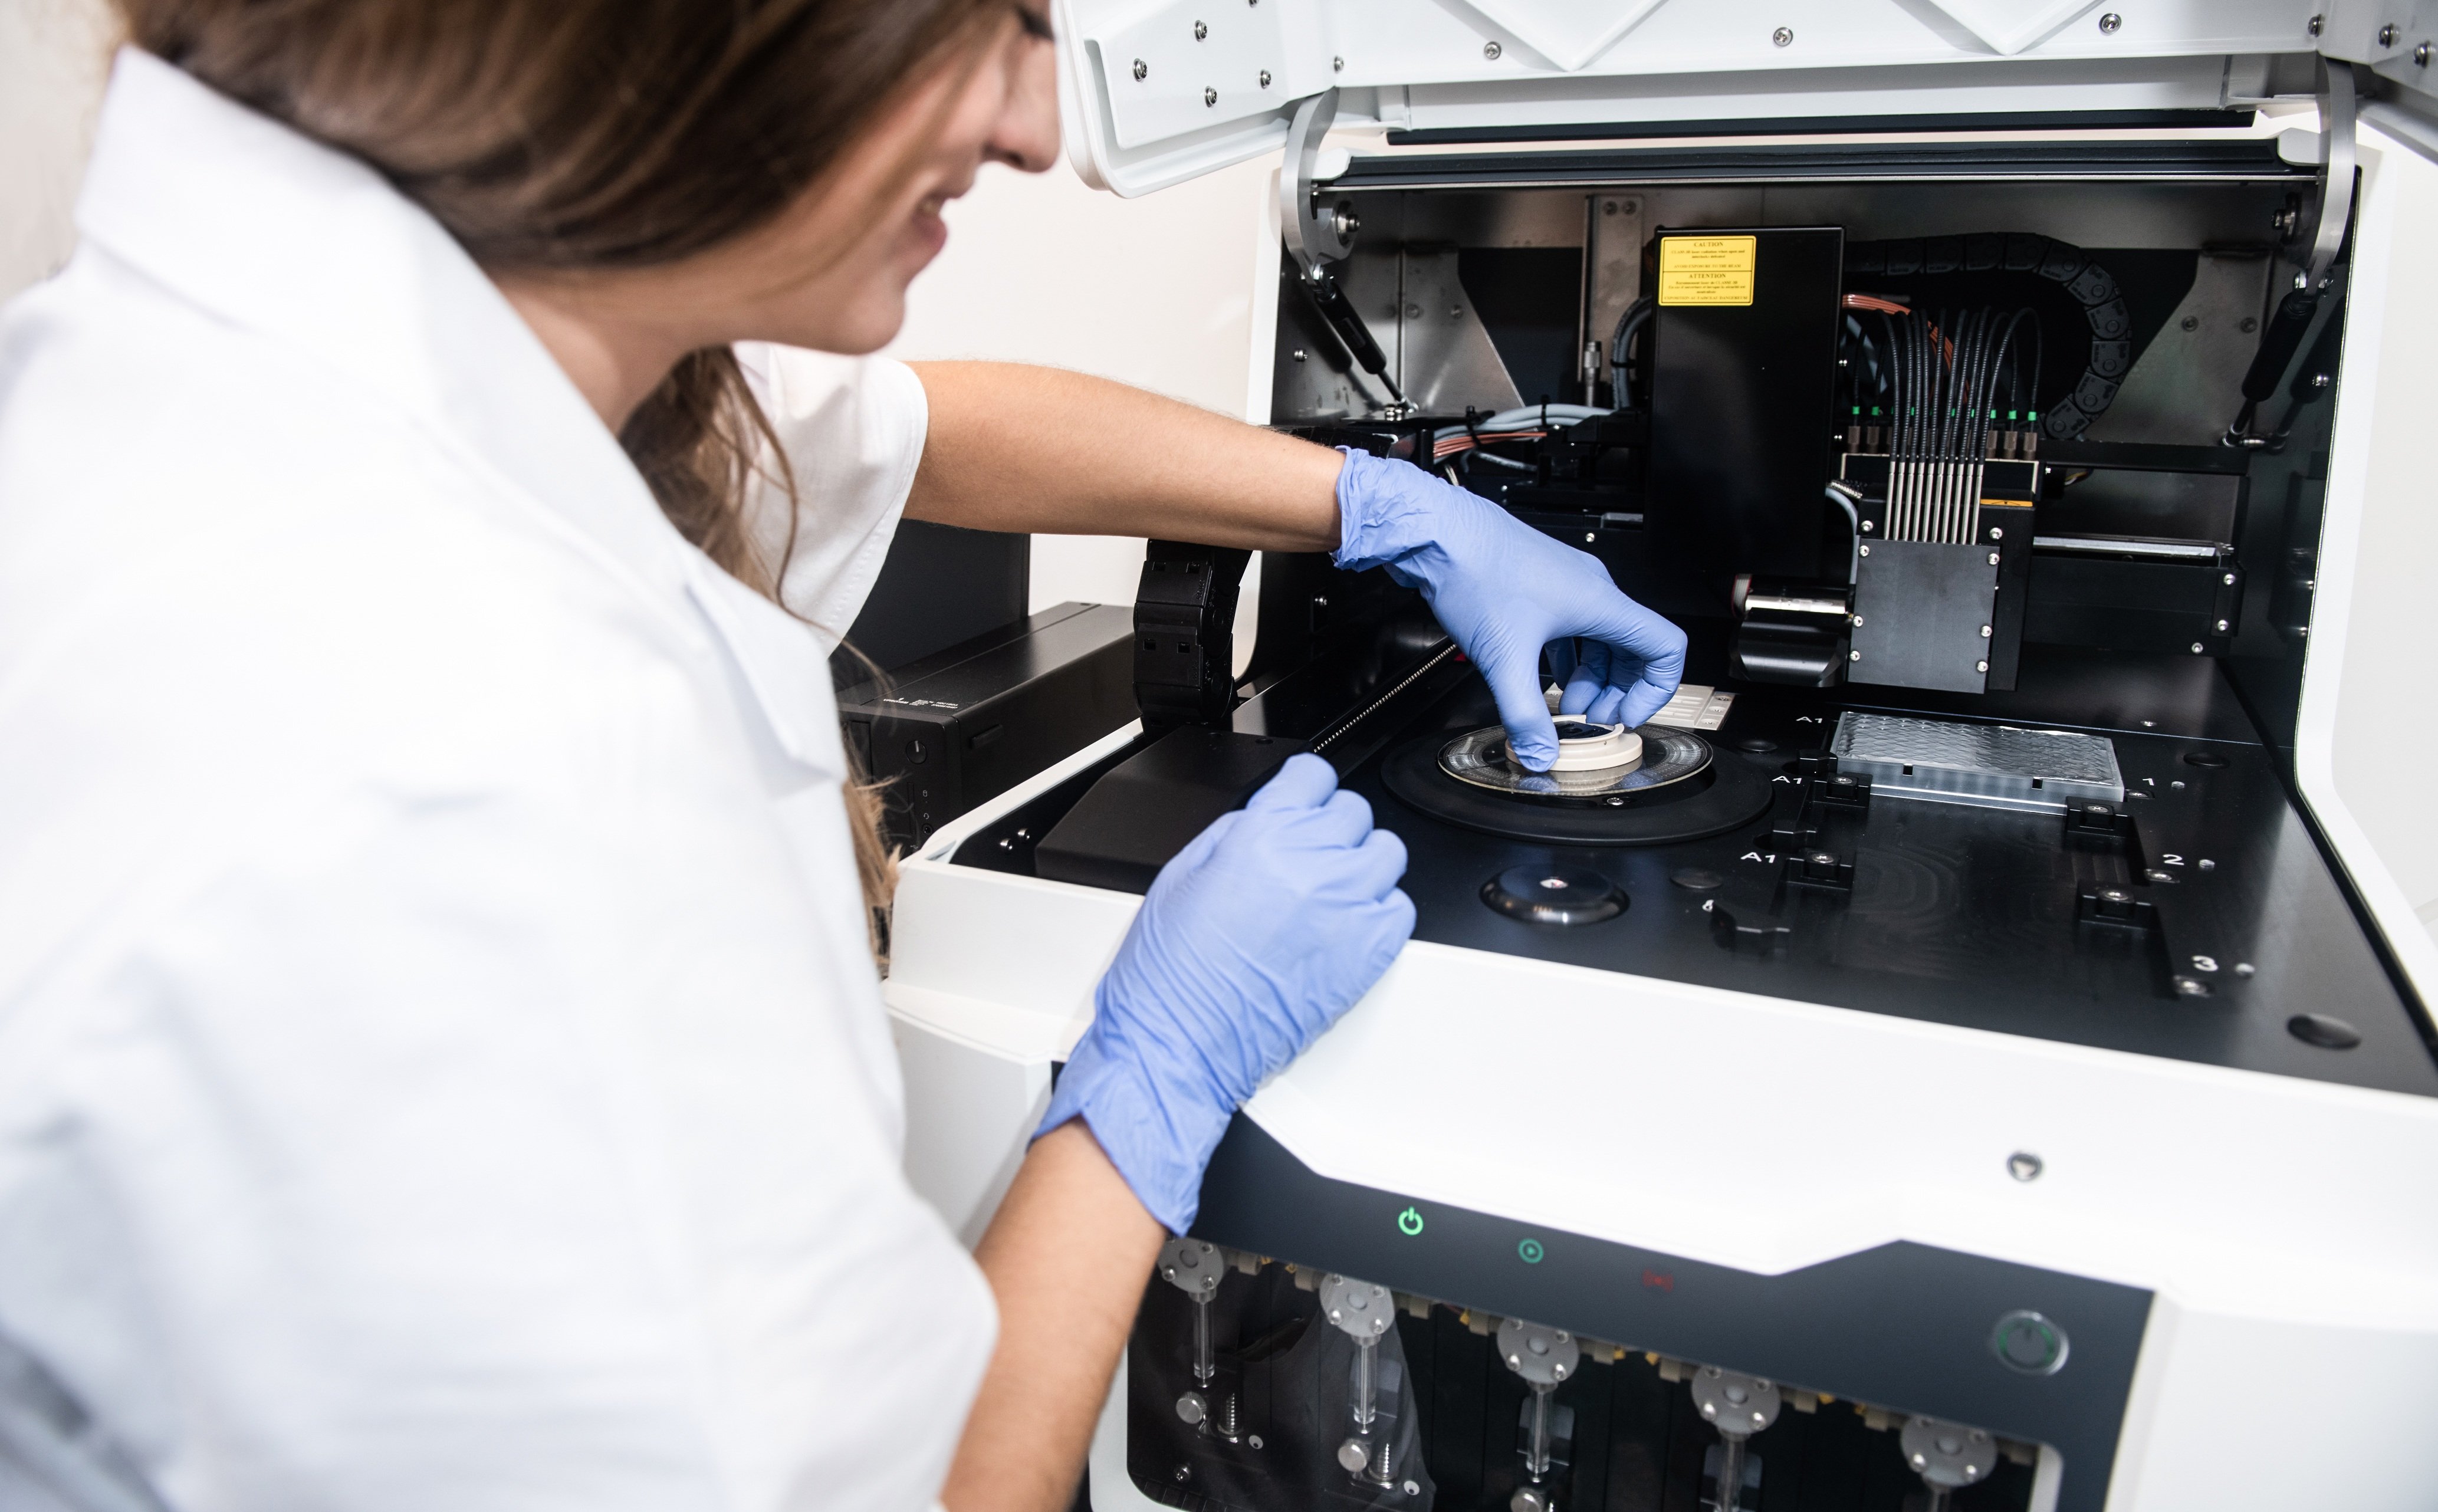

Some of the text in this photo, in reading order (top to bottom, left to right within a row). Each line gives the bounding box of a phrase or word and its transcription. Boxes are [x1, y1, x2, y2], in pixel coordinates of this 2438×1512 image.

[1772, 775, 1802, 784] A1
[2142, 778, 2154, 786] 1
[1740, 852, 1776, 863] A1
[2163, 854, 2184, 866] 2
[2193, 955, 2218, 971] 3
